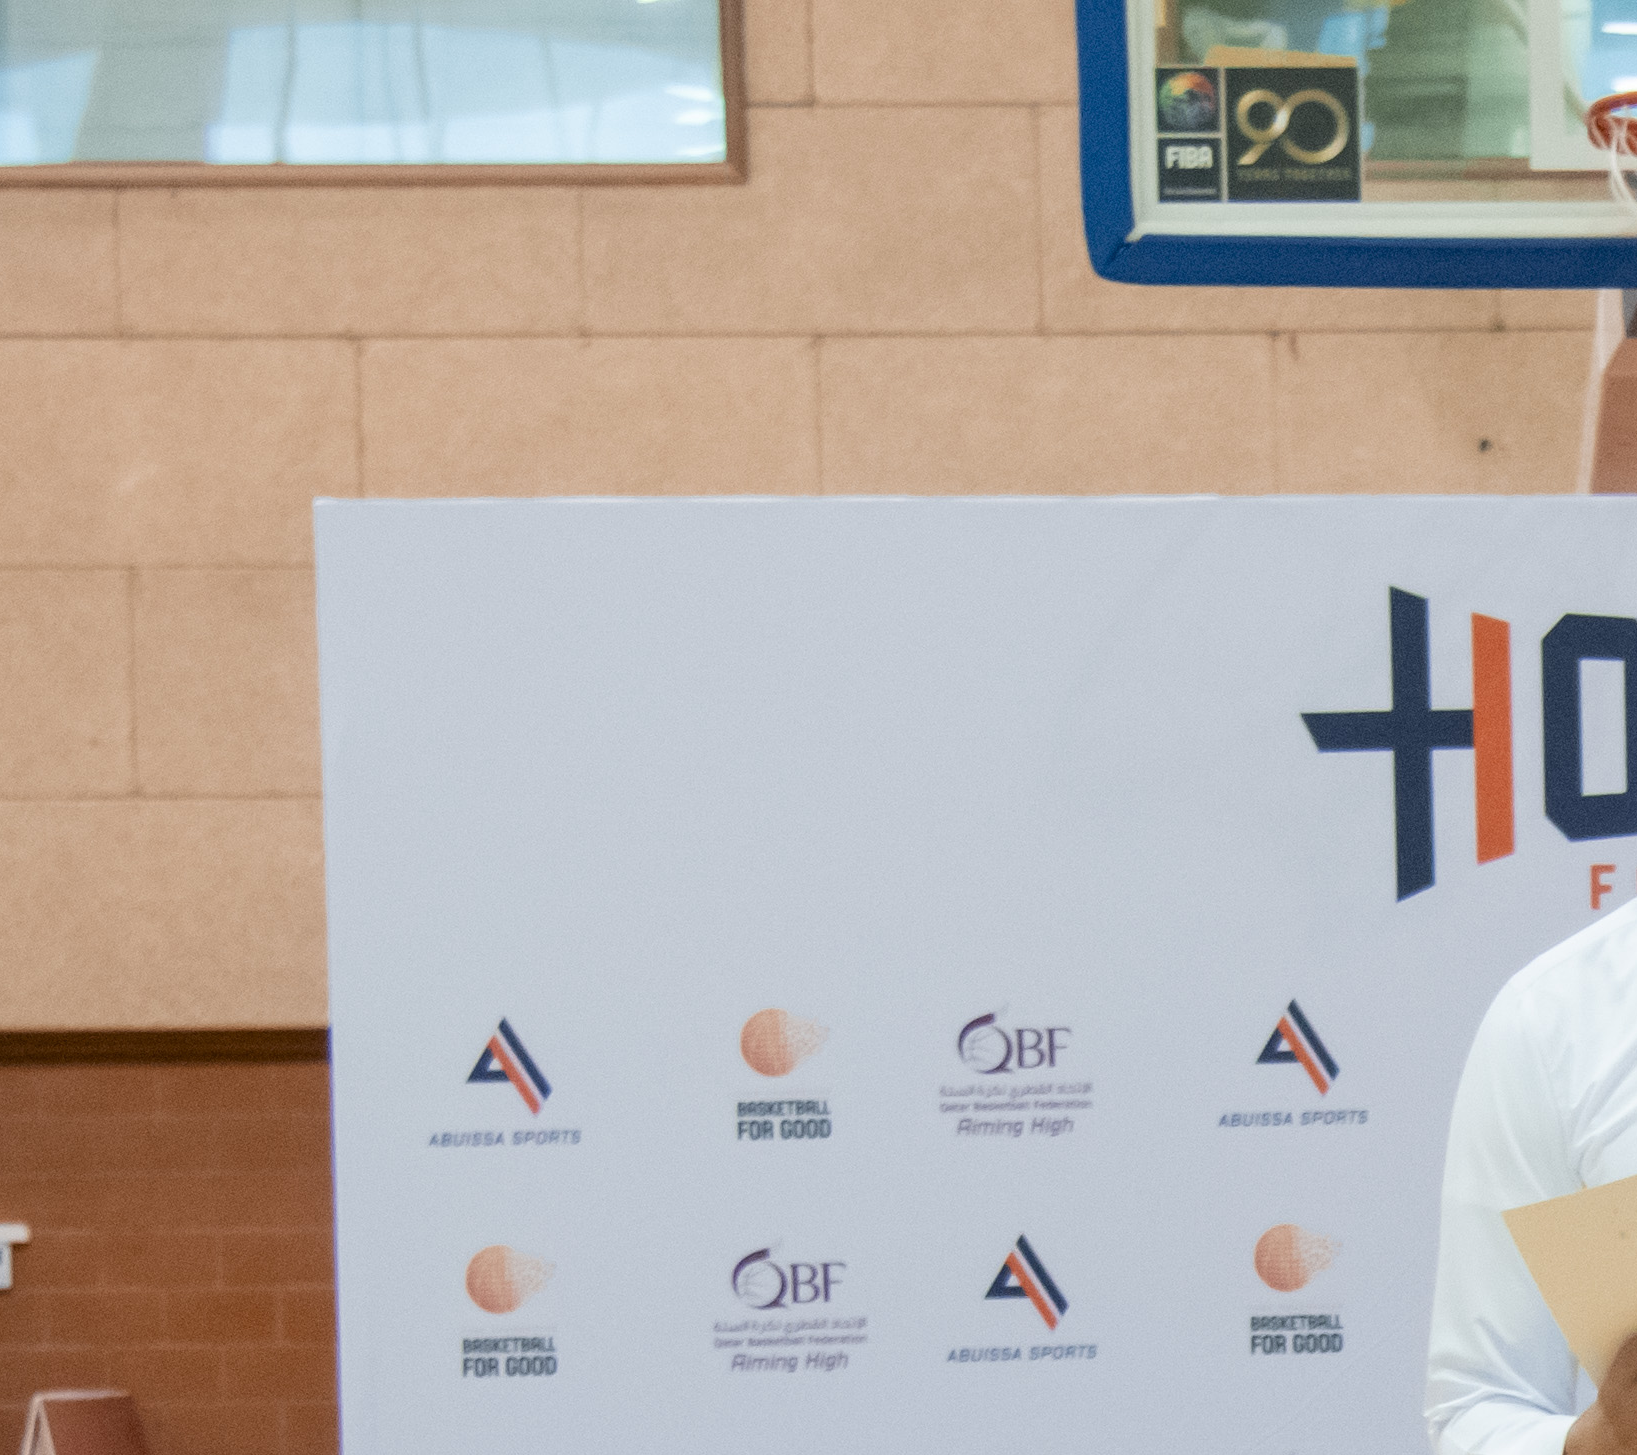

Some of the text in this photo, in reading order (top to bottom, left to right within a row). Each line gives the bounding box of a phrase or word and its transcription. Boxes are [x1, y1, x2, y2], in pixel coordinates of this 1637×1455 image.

[957, 1012, 1072, 1075] QBF
[737, 1100, 830, 1117] BASKETBALL
[1217, 1109, 1369, 1128] ABUISSA SPORTS
[429, 1129, 581, 1148] ABUISSA SPORTS
[738, 1119, 832, 1140] FOR GOOD
[731, 1247, 847, 1310] QBF
[1250, 1314, 1343, 1331] BASKETBALL
[463, 1337, 556, 1354] BASKETBALL
[1251, 1333, 1345, 1354] FOR GOOD
[946, 1344, 1097, 1363] ABUISSA SPORTS
[464, 1356, 558, 1377] FOR GOOD
